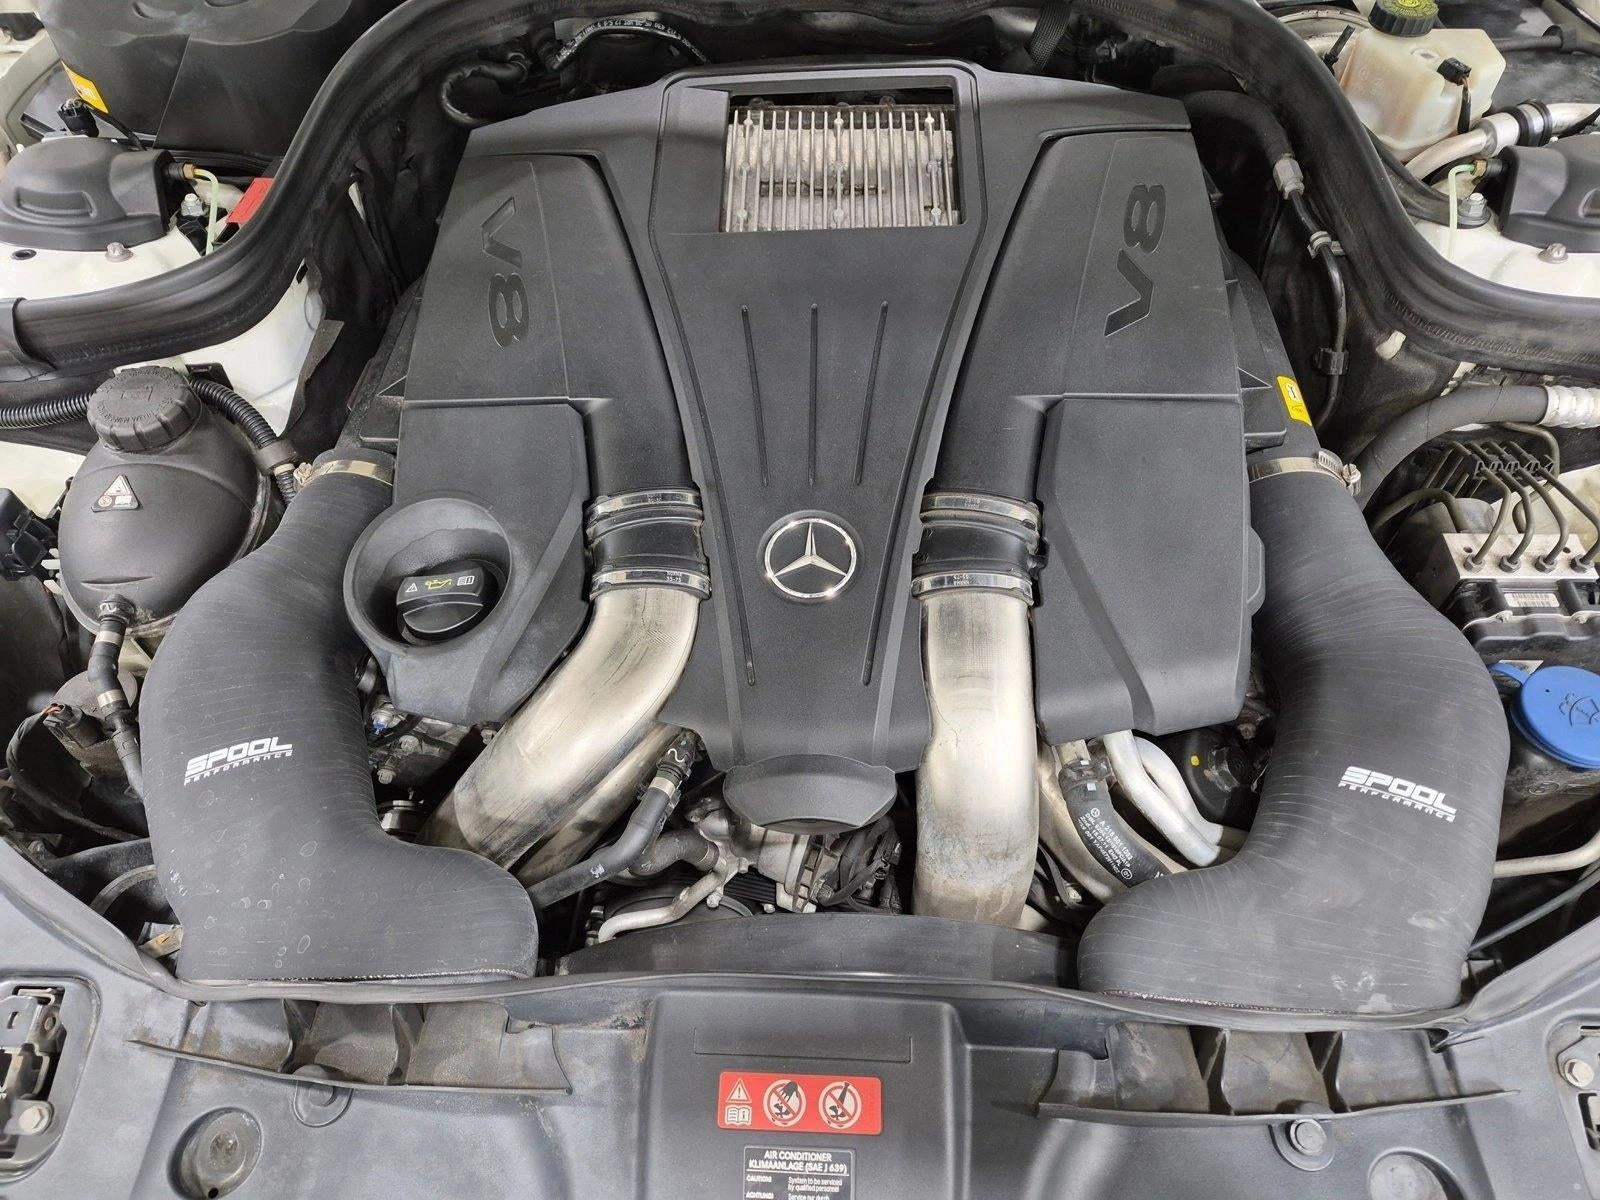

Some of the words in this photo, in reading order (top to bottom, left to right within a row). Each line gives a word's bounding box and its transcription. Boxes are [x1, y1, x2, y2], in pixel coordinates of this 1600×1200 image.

[481, 196, 531, 348] V8
[1104, 183, 1166, 337] V8
[184, 750, 293, 786] PERFORMANCE
[185, 736, 292, 778] SPOOL
[1338, 782, 1456, 823] PERFORMANCE
[1341, 766, 1457, 815] SPOOL
[749, 1159, 804, 1171] KLIMAANLAGE
[805, 1162, 823, 1174] (SAE
[829, 1163, 847, 1174] 639)
[764, 1150, 777, 1160] AIR
[779, 1151, 832, 1162] CONDITIONER
[788, 1176, 807, 1186] System
[808, 1177, 814, 1185] to
[814, 1177, 821, 1185] be
[821, 1178, 843, 1186] serviced
[788, 1184, 795, 1192] by
[795, 1184, 816, 1192] qualified
[816, 1185, 840, 1193] personnel
